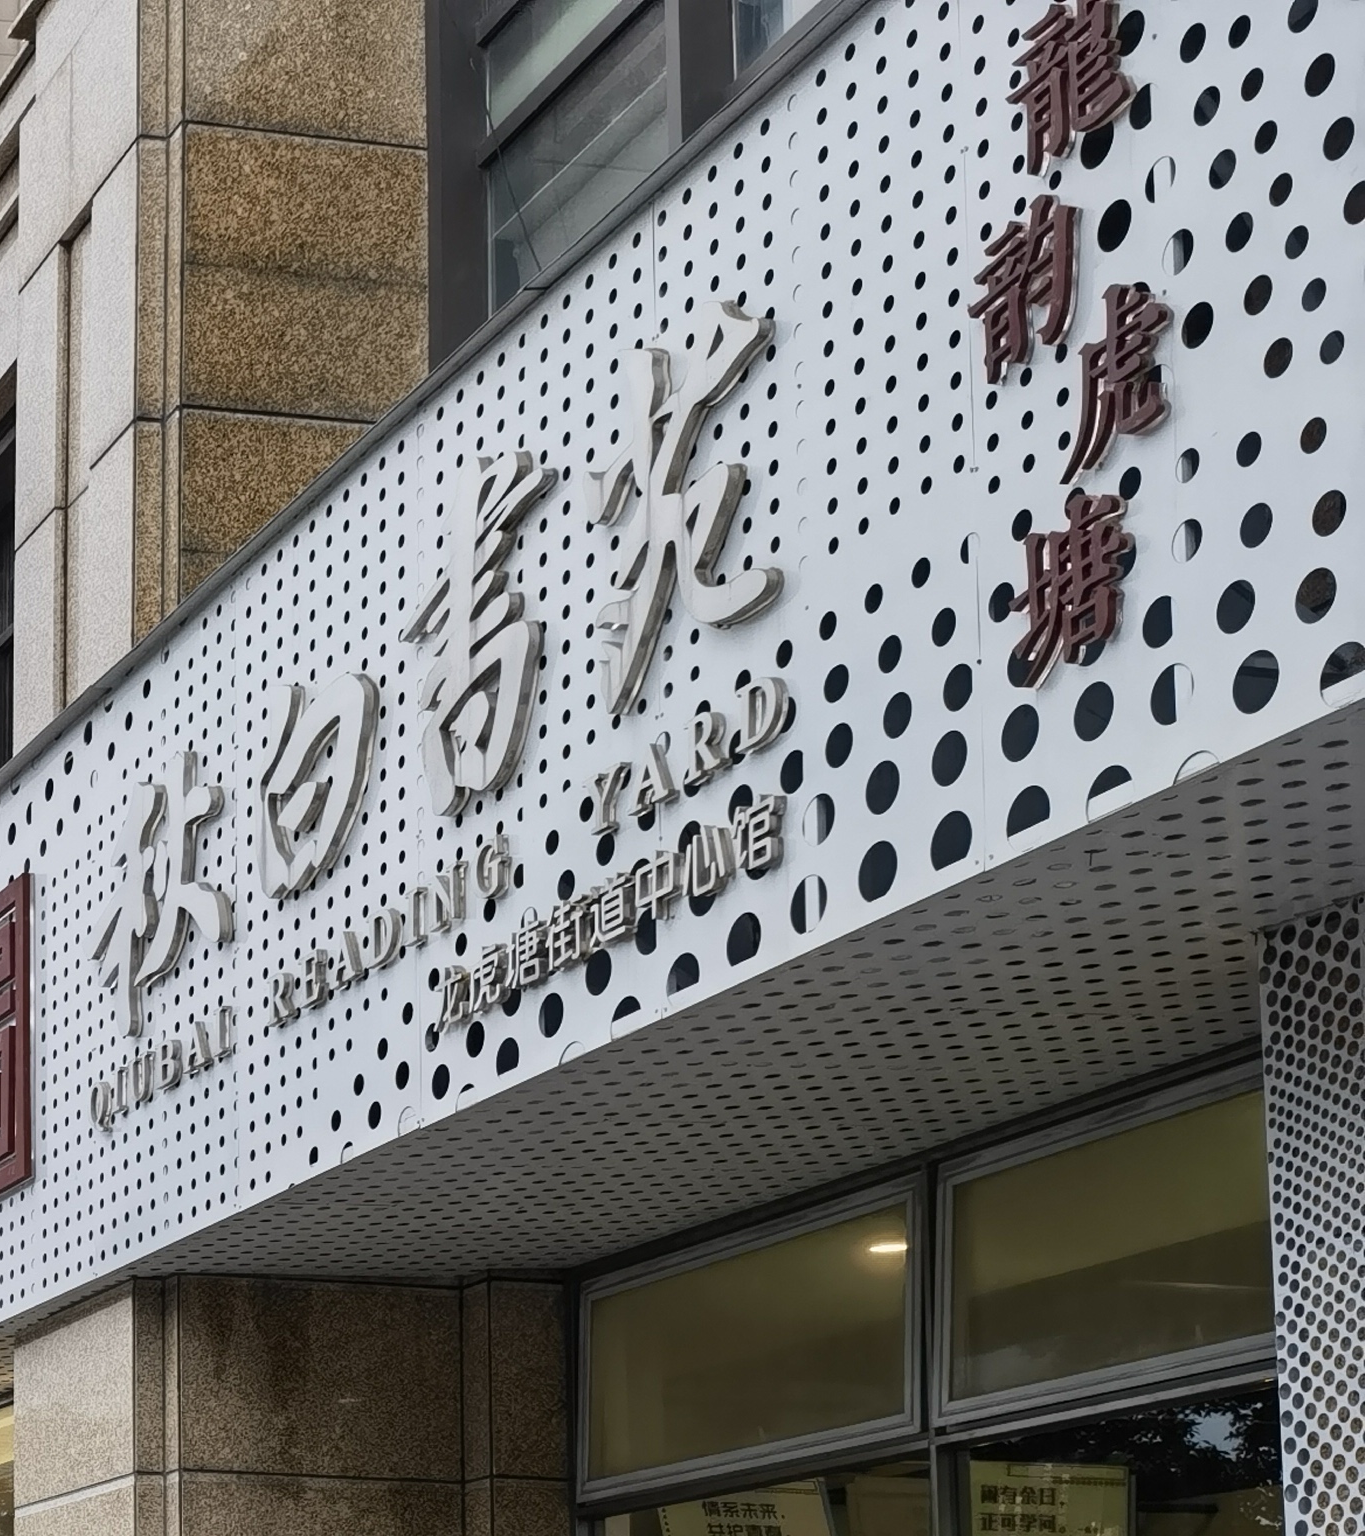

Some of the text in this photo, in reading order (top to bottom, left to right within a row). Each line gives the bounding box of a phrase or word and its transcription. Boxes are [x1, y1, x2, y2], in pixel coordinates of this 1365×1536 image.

[89, 1003, 238, 1134] QIUBAI
[267, 835, 512, 1028] READING
[587, 674, 792, 837] YARD
[433, 793, 786, 1033] 龙虎塘街道中心馆
